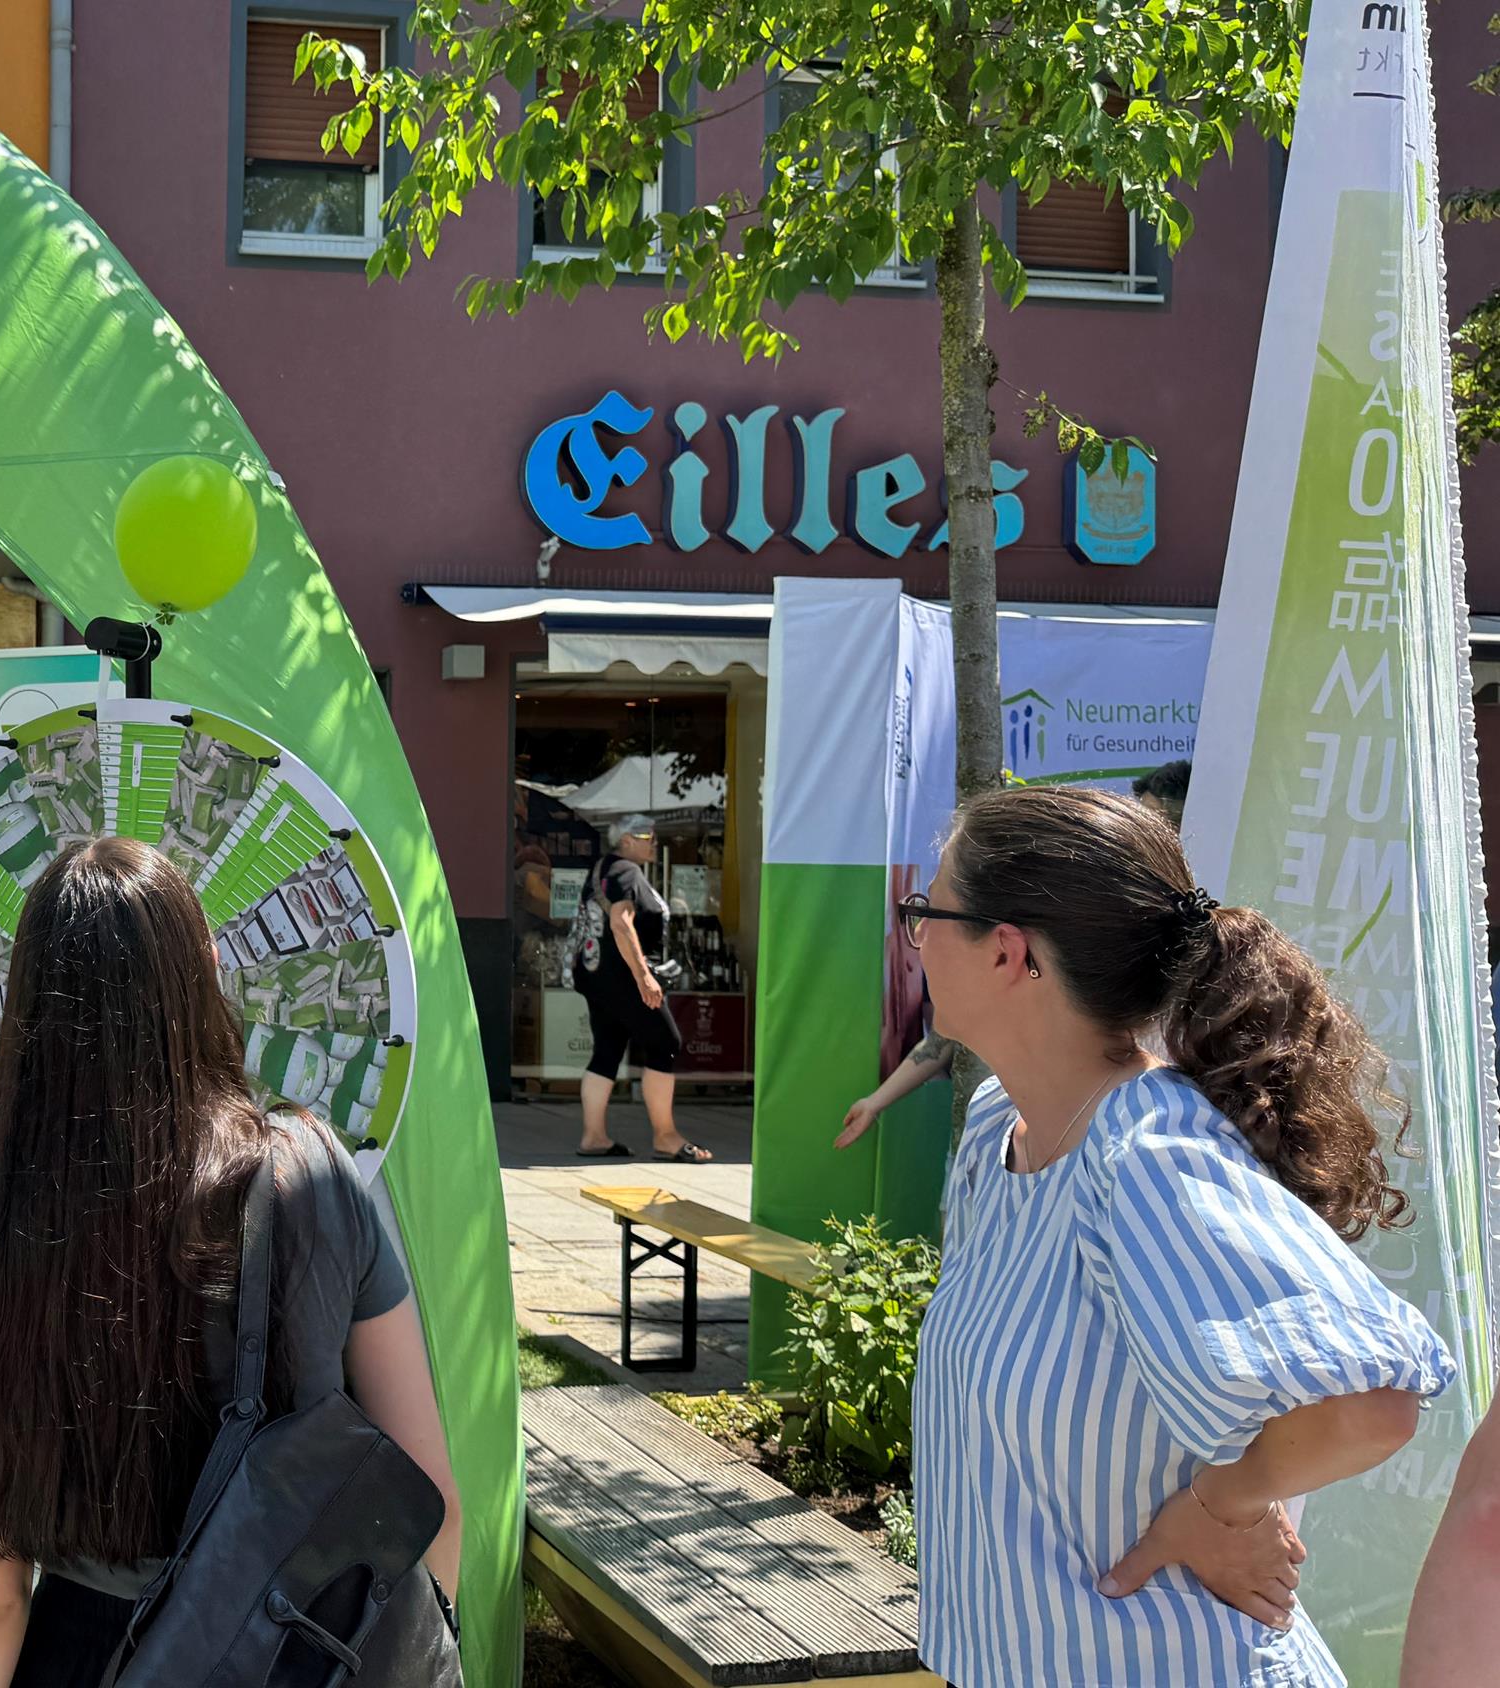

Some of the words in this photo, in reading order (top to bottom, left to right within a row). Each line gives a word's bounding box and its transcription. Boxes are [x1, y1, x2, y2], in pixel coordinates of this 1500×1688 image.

[525, 391, 1029, 558] Eilles
[1066, 699, 1201, 724] Neumarkt
[1067, 734, 1089, 752] für
